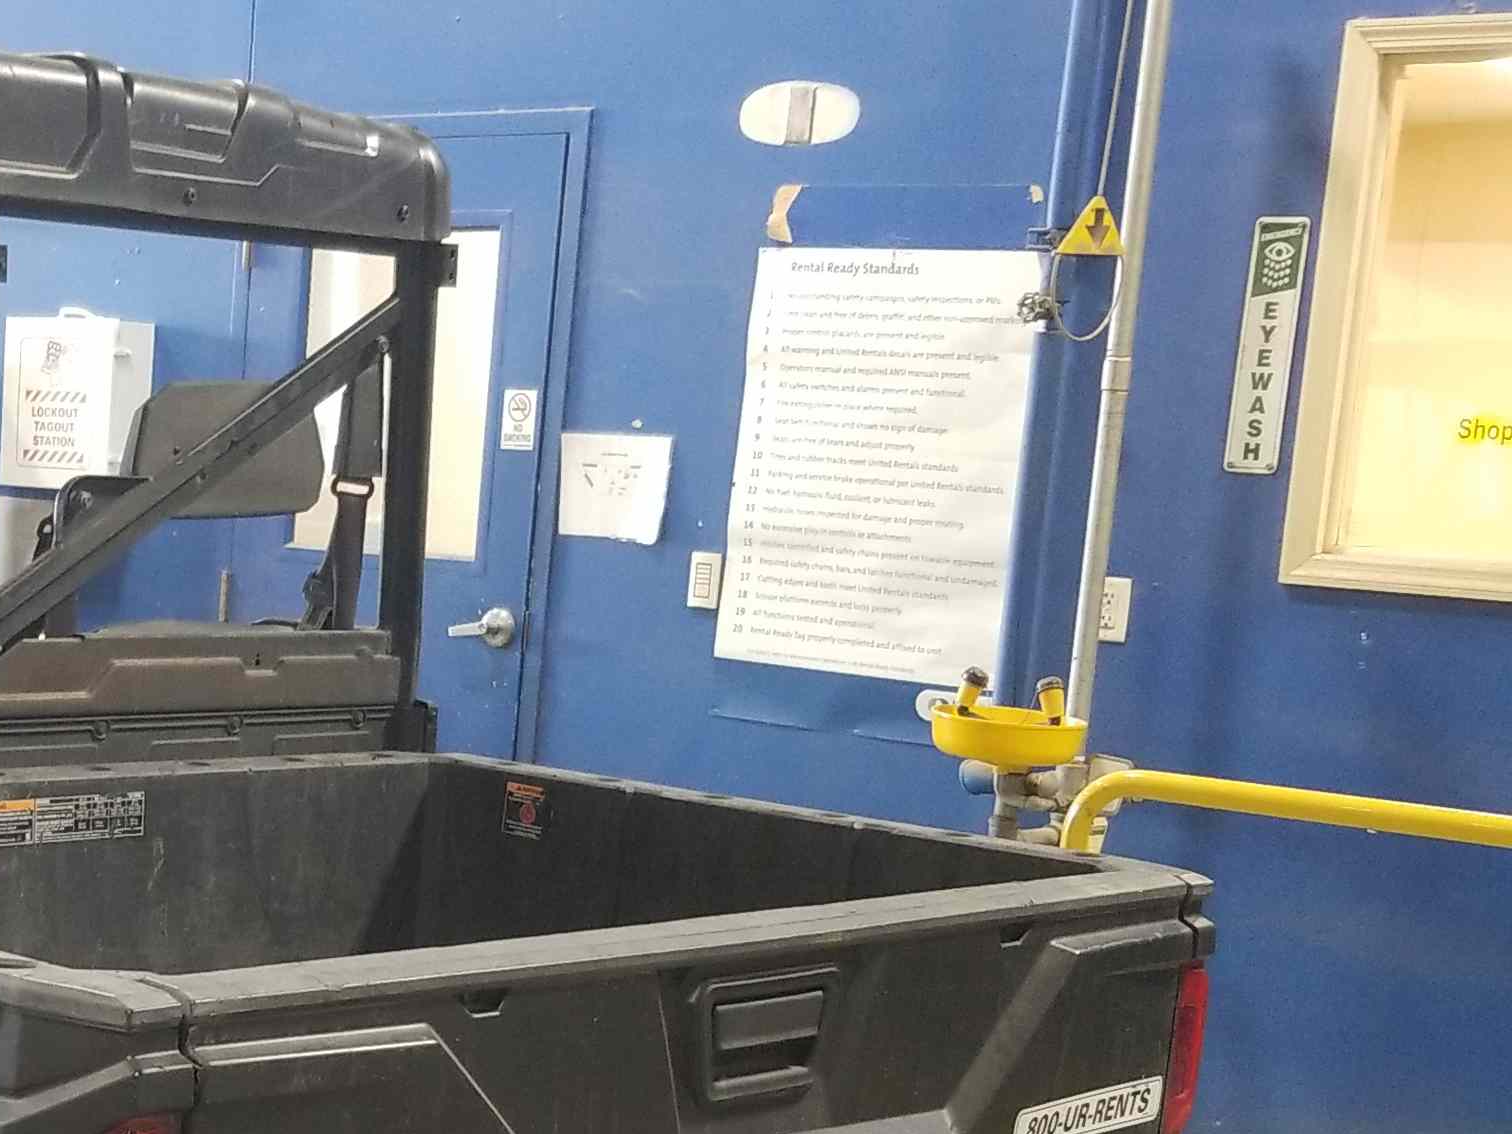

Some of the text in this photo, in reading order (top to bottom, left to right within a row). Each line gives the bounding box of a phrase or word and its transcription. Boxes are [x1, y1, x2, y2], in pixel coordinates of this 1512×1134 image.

[790, 260, 921, 277] Rental Ready Standards
[904, 330, 920, 340] and
[820, 345, 835, 354] and
[911, 350, 925, 358] are
[924, 350, 955, 361] present
[955, 351, 972, 360] and
[842, 365, 857, 374] and
[1242, 301, 1280, 462] EYEWASH
[840, 382, 856, 392] and
[909, 386, 925, 395] and
[31, 406, 80, 418] LOCKOUT
[33, 421, 76, 432] TAGOUT
[1457, 417, 1512, 446] Shop
[32, 435, 75, 447] STATION
[844, 437, 860, 447] and
[751, 449, 763, 460] 10
[749, 467, 760, 478] 11
[909, 479, 936, 490] United
[743, 519, 754, 530] 14
[892, 514, 908, 524] and
[734, 605, 746, 617] 19
[732, 622, 743, 634] 20
[875, 639, 891, 649] and
